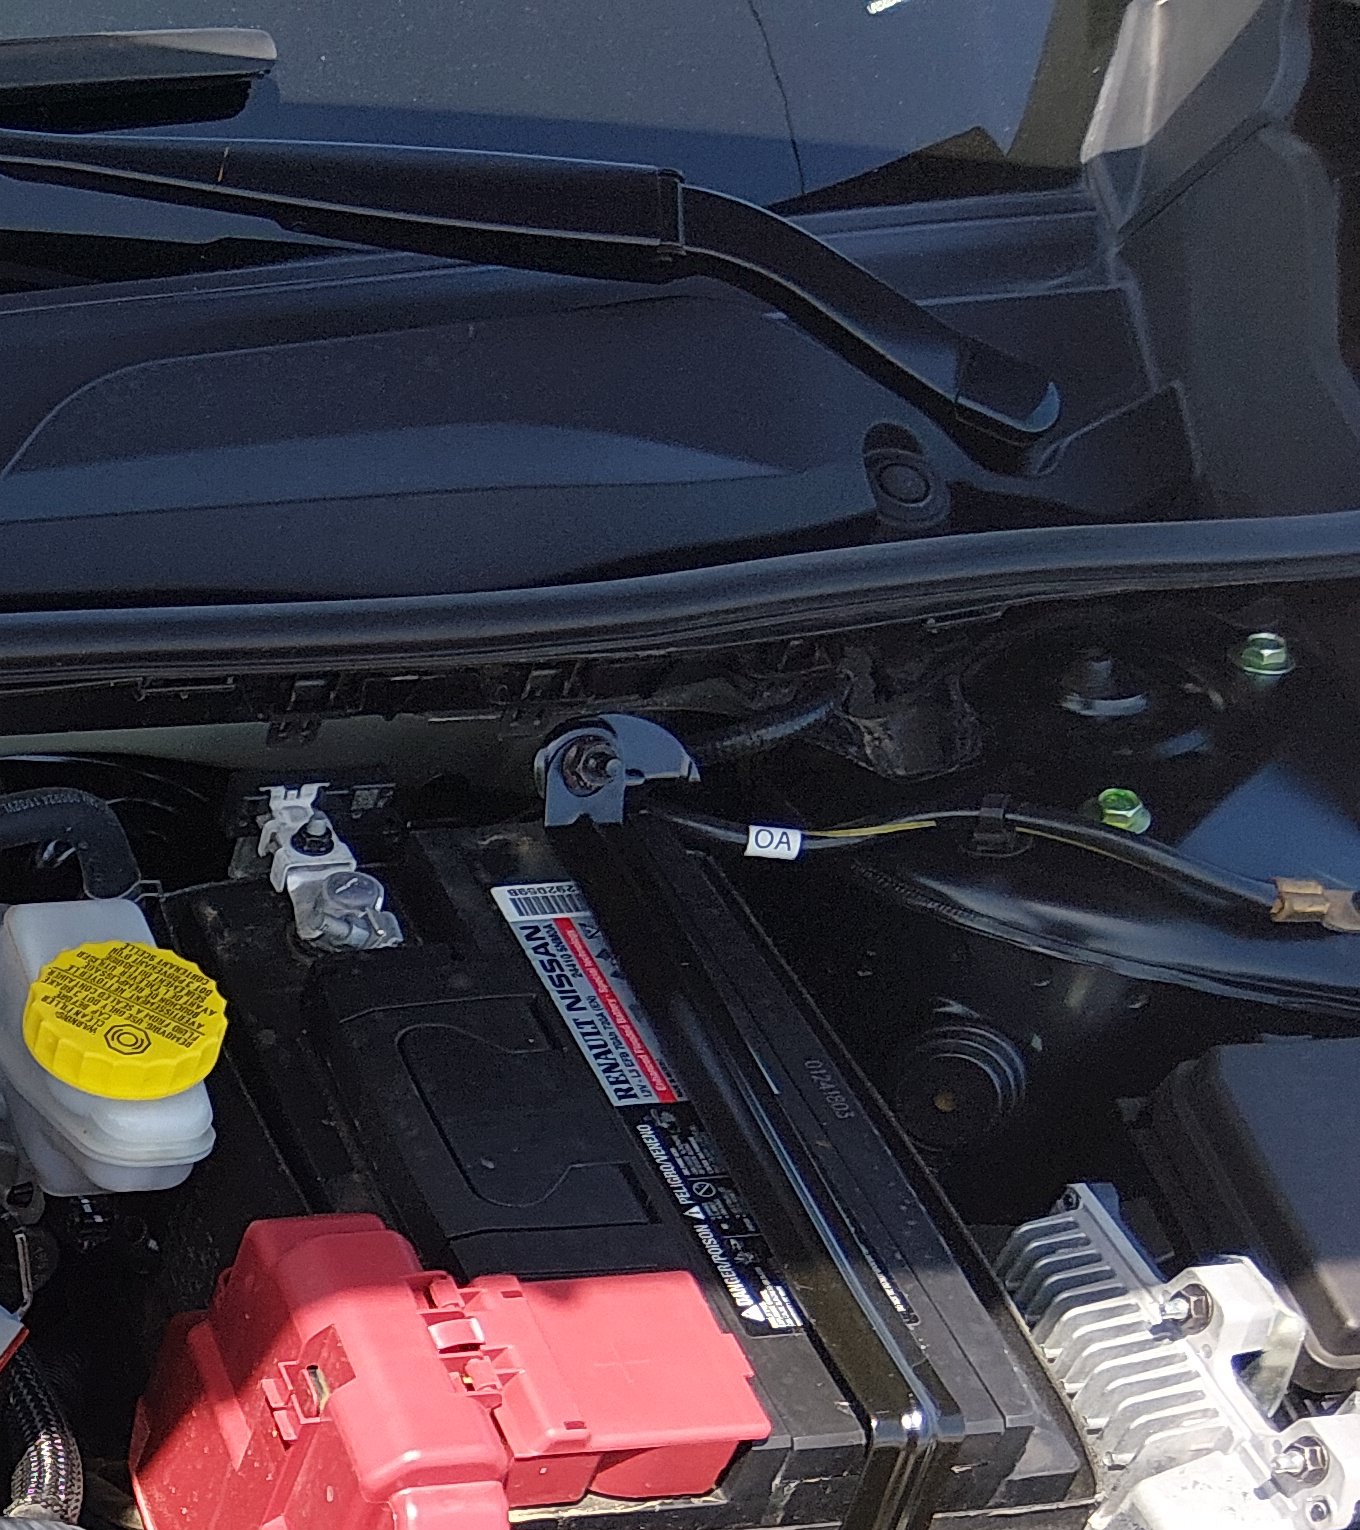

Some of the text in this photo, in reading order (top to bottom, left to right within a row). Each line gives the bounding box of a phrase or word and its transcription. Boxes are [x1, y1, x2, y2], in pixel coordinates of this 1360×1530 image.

[755, 828, 791, 851] OA
[90, 1006, 112, 1021] CAP
[517, 924, 639, 1101] RENAULT NISSAN
[634, 1123, 695, 1205] PELIGRO/VENENO
[691, 1223, 756, 1307] DANGER/POISON
